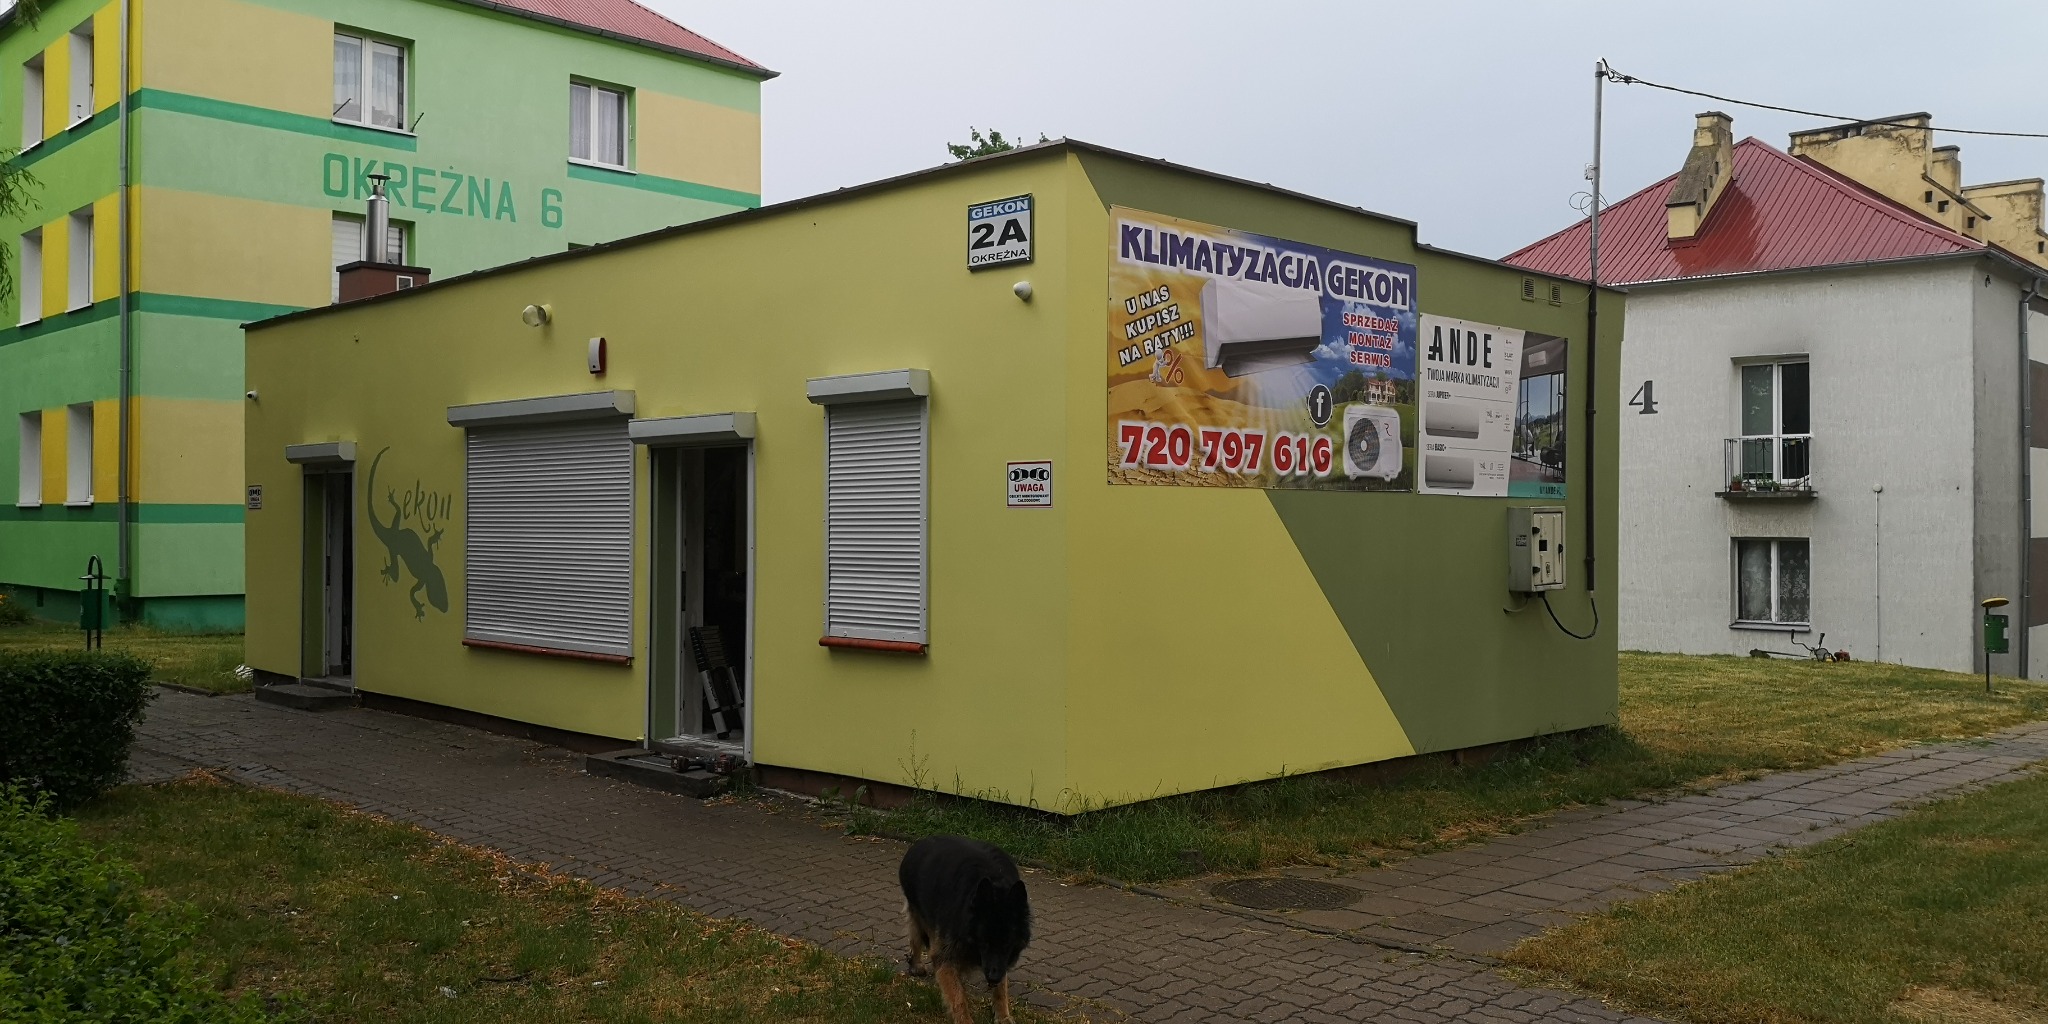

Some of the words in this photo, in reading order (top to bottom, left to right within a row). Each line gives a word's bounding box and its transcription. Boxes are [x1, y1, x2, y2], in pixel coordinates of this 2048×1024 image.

[323, 152, 516, 223] OKRĘŻNA
[541, 187, 562, 228] 6
[971, 199, 1029, 219] GEKON
[970, 218, 1028, 250] 2A
[1121, 224, 1320, 291] KLIMATYZACJA
[1327, 264, 1408, 306] GEKON
[1125, 297, 1137, 314] U
[1139, 285, 1170, 310] NAS
[1125, 304, 1180, 339] KUPISZ
[1343, 312, 1398, 332] SPRZEDAŻ
[1119, 344, 1142, 366] NA
[1143, 321, 1194, 356] RATY!!!
[1349, 331, 1392, 350] MONTAŻ
[1428, 325, 1492, 368] ANDE
[1350, 351, 1390, 367] SERWIS
[1427, 368, 1444, 382] TWOJA
[1446, 370, 1465, 385] MARKA
[1465, 374, 1499, 389] KLIMATYZACJI
[1629, 380, 1658, 415] 4
[1121, 425, 1191, 466] 720
[1202, 430, 1264, 470] 797
[1274, 435, 1330, 473] 616
[1014, 483, 1045, 492] UWAGA
